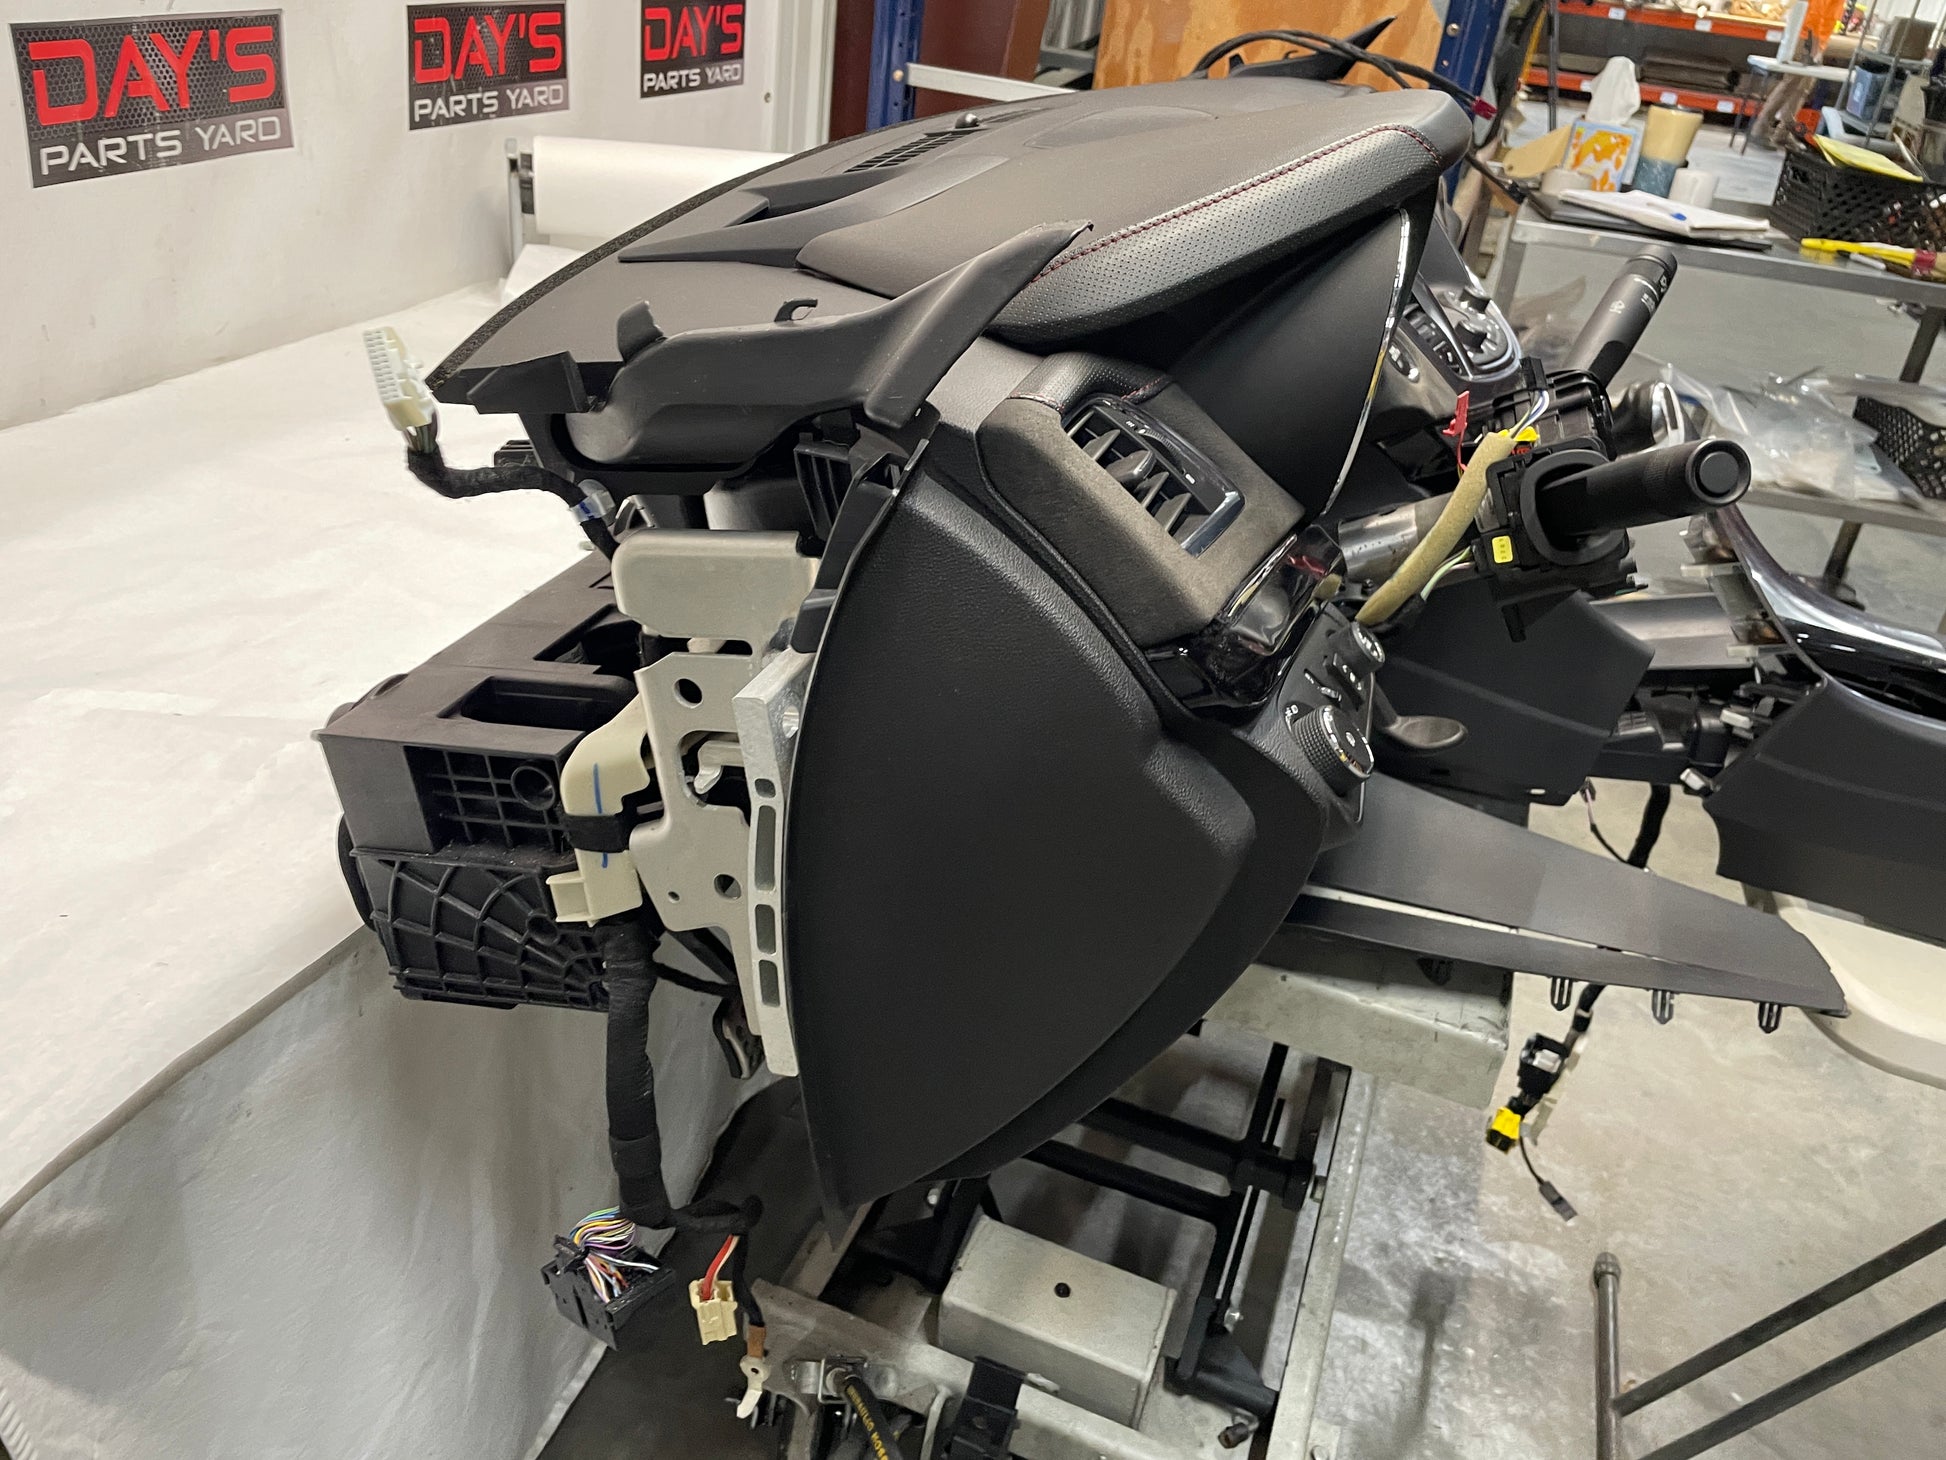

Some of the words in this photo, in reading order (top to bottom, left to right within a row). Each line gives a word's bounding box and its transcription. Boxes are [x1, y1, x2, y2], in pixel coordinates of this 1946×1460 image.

[415, 12, 562, 83] DAY'S
[645, 5, 742, 60] DAY'S
[29, 26, 275, 125] DAY'S
[414, 90, 499, 122] PARTS
[506, 84, 564, 110] YARD
[643, 68, 701, 93] PARTS
[705, 63, 741, 84] YARD
[39, 129, 183, 176] PARTS
[195, 116, 281, 151] YARD
